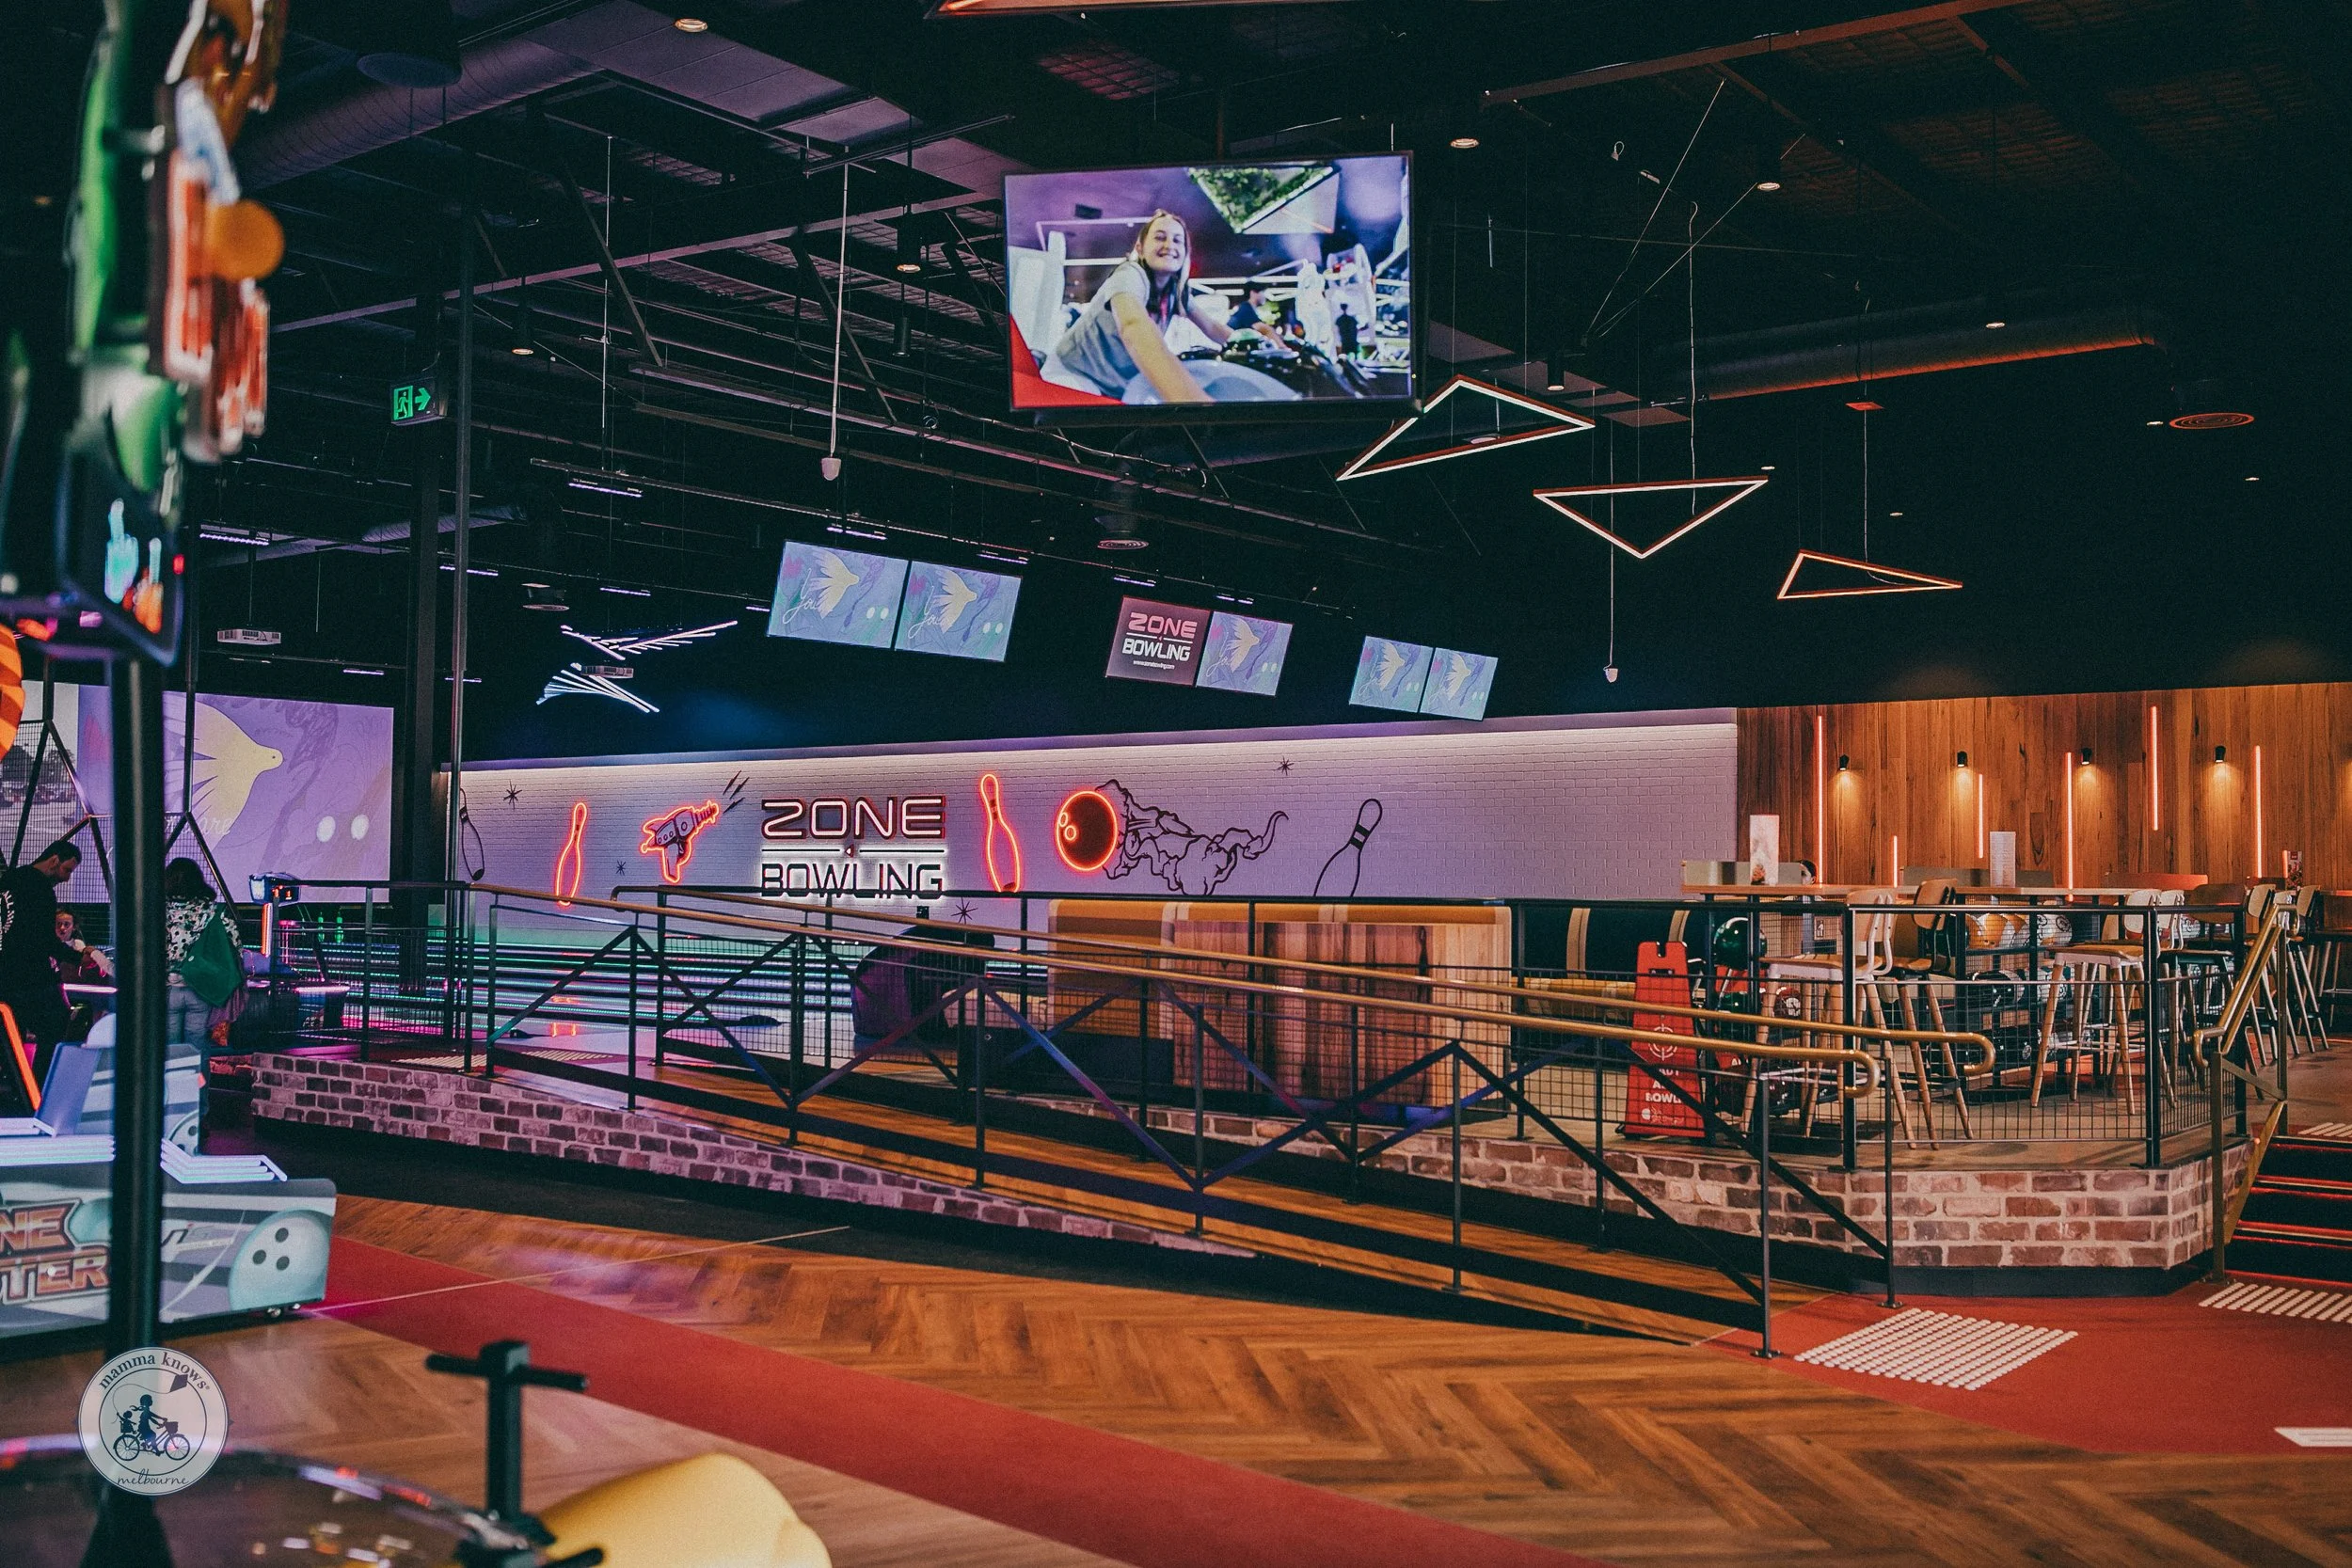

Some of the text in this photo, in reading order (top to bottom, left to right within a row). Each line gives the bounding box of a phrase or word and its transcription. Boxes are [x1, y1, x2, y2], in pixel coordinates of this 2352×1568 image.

[1128, 611, 1198, 639] ZONE
[1121, 638, 1191, 661] BOWLING
[761, 796, 946, 840] ZONE
[761, 863, 943, 900] BOWLING
